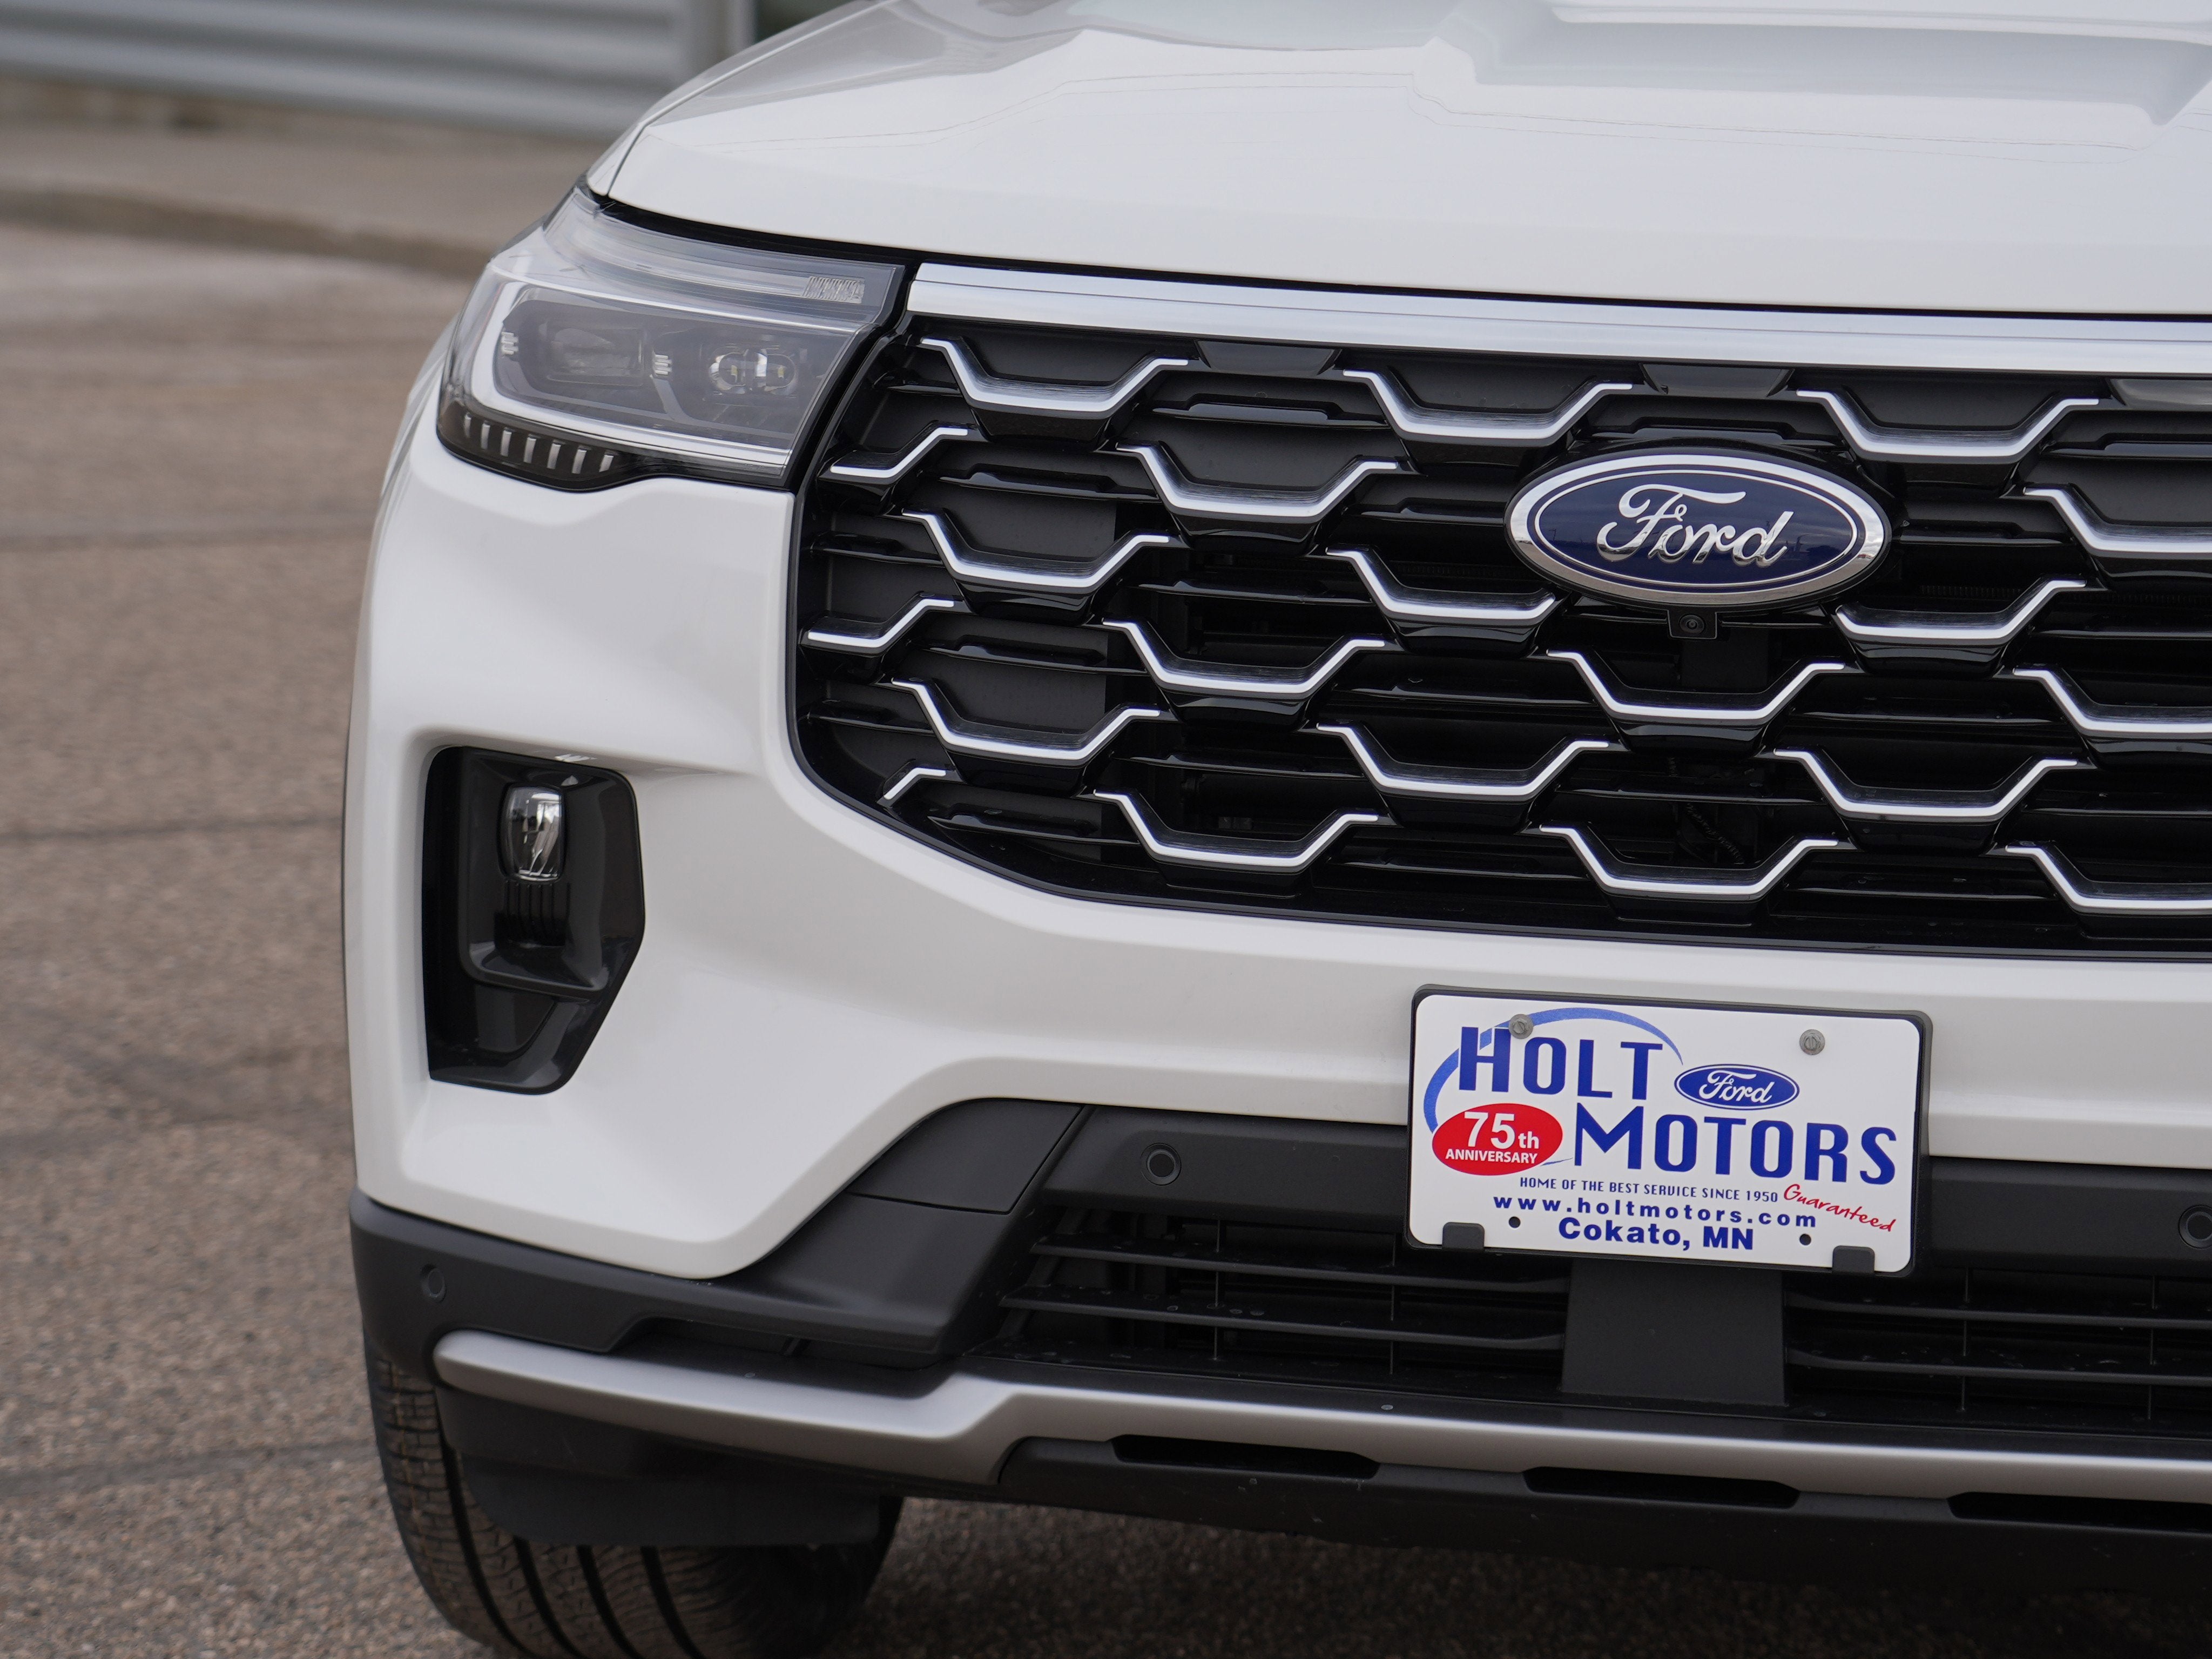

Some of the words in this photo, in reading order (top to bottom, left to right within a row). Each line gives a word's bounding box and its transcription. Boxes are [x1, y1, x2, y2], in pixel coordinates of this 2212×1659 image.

[1596, 484, 1794, 567] Ford
[1459, 1027, 1663, 1100] HOLT
[1698, 1070, 1775, 1103] Ford
[1464, 1111, 1539, 1149] 75th
[1574, 1102, 1897, 1185] MOTORS
[1445, 1148, 1538, 1164] ANNIVERSARY
[1520, 1177, 1557, 1189] HOME
[1562, 1179, 1577, 1190] OF
[1582, 1180, 1604, 1192] THE
[1609, 1182, 1640, 1194] BEST
[1644, 1184, 1697, 1198] SERVICE
[1702, 1188, 1740, 1201] SINCE
[1745, 1190, 1778, 1203] 1950
[1783, 1184, 1897, 1232] Guaranteed
[1493, 1196, 1816, 1228] www.holtmotors.com
[1559, 1217, 1690, 1251] Cokato,
[1703, 1226, 1754, 1250] MN
